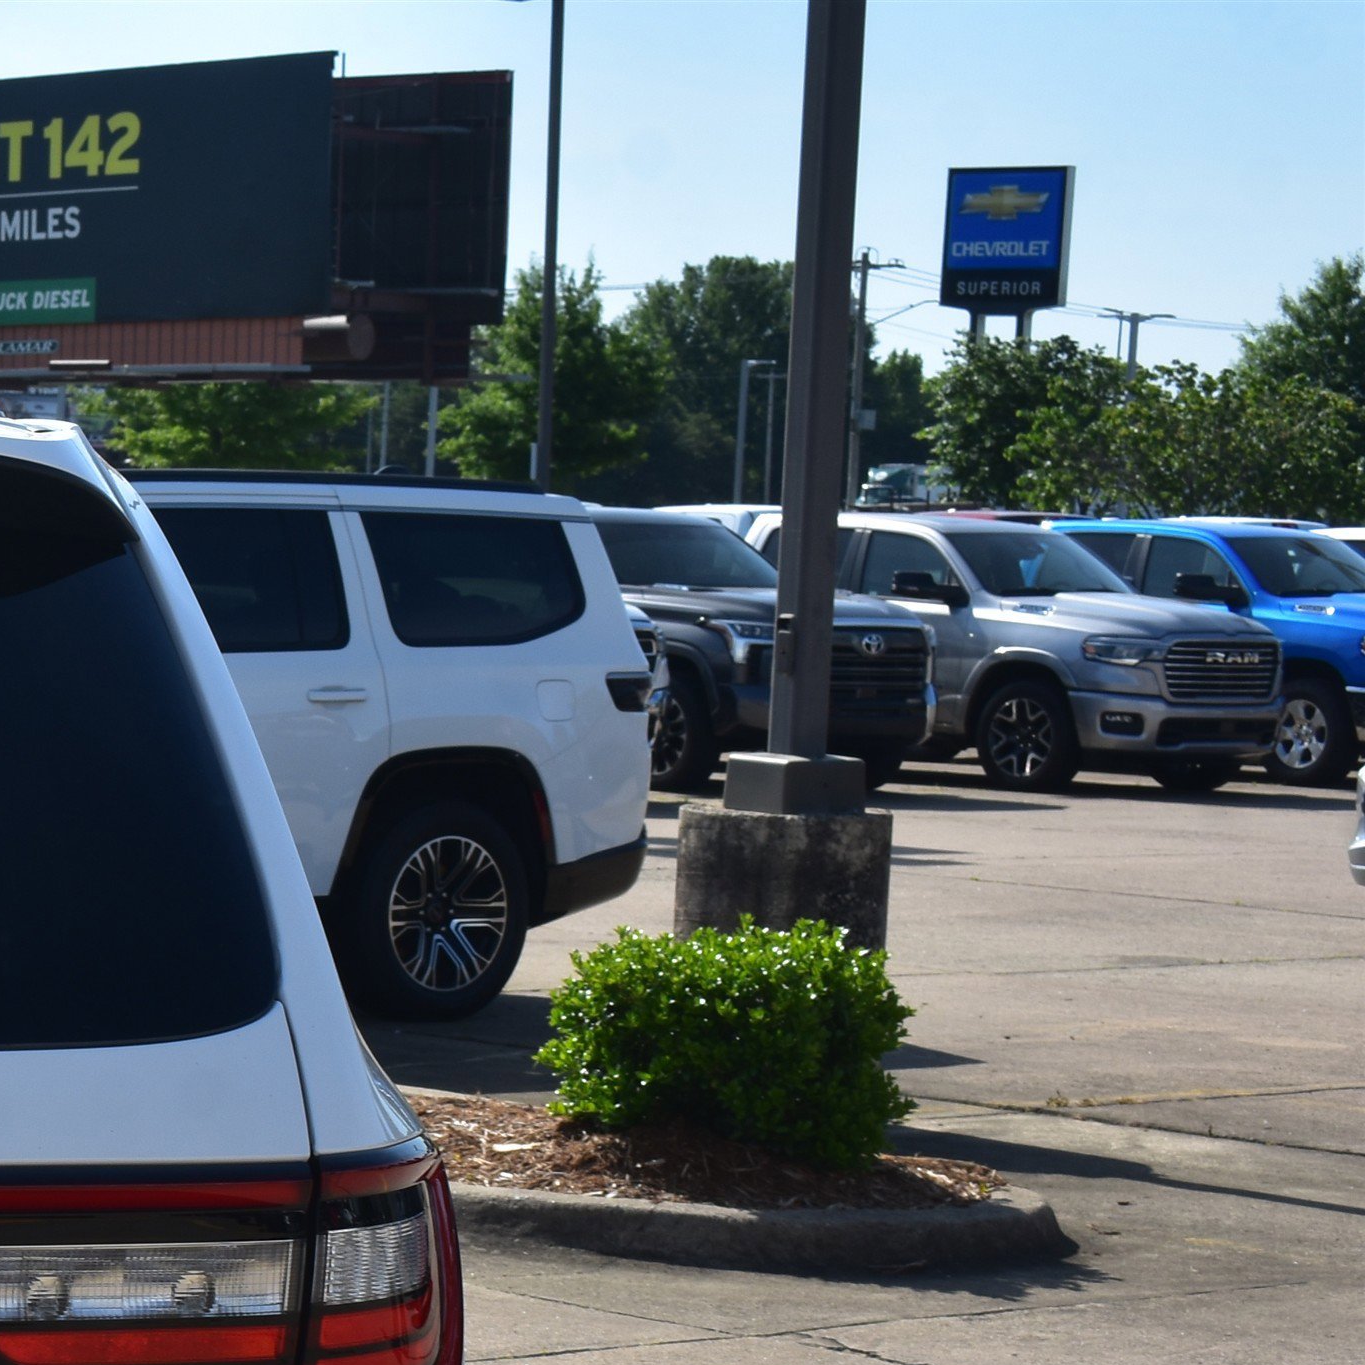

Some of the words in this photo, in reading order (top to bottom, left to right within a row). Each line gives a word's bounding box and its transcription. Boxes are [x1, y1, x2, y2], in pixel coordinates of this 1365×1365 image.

[43, 111, 141, 180] 142
[0, 206, 81, 242] MILES
[952, 241, 1049, 257] CHEVROLET
[957, 281, 1041, 295] SUPERIOR
[32, 289, 90, 309] DIESEL
[1206, 652, 1259, 663] RAM
